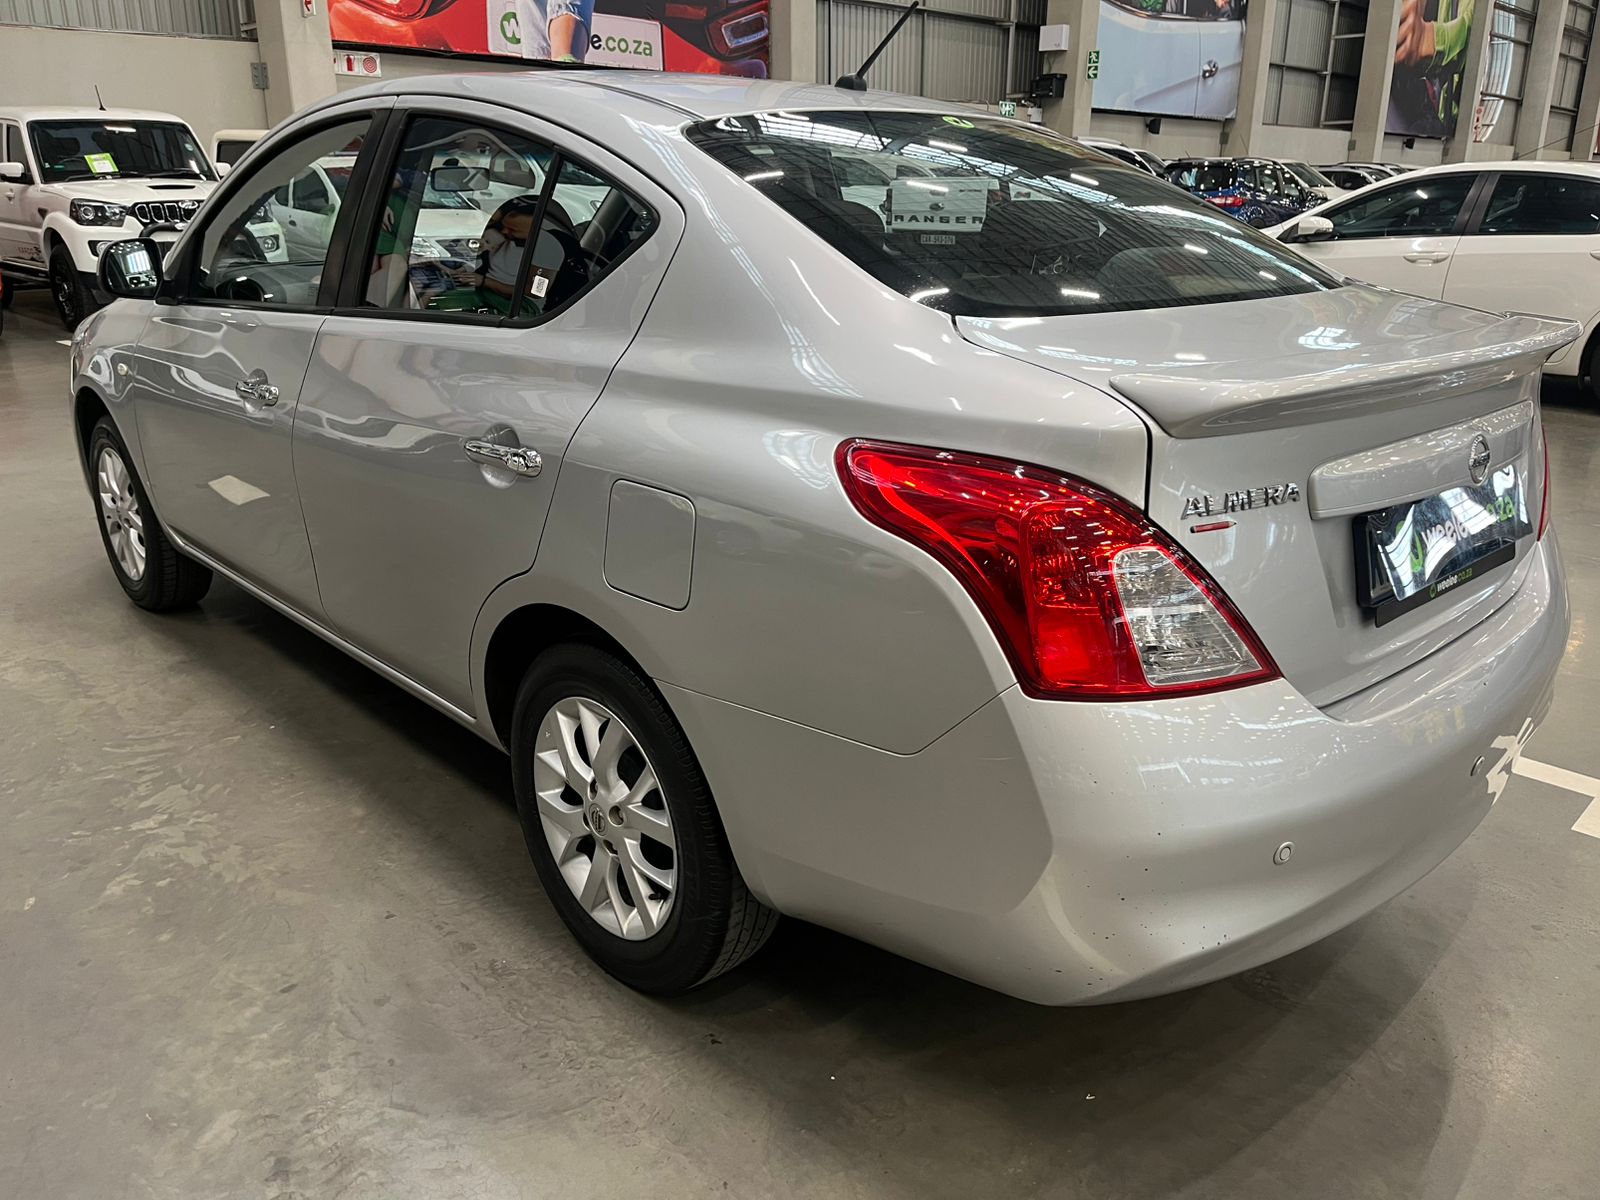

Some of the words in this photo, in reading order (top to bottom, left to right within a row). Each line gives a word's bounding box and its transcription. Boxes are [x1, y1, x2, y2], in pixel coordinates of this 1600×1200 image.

[590, 34, 653, 57] e.co.za
[894, 214, 983, 224] RANGER
[1180, 482, 1300, 520] ALMERA
